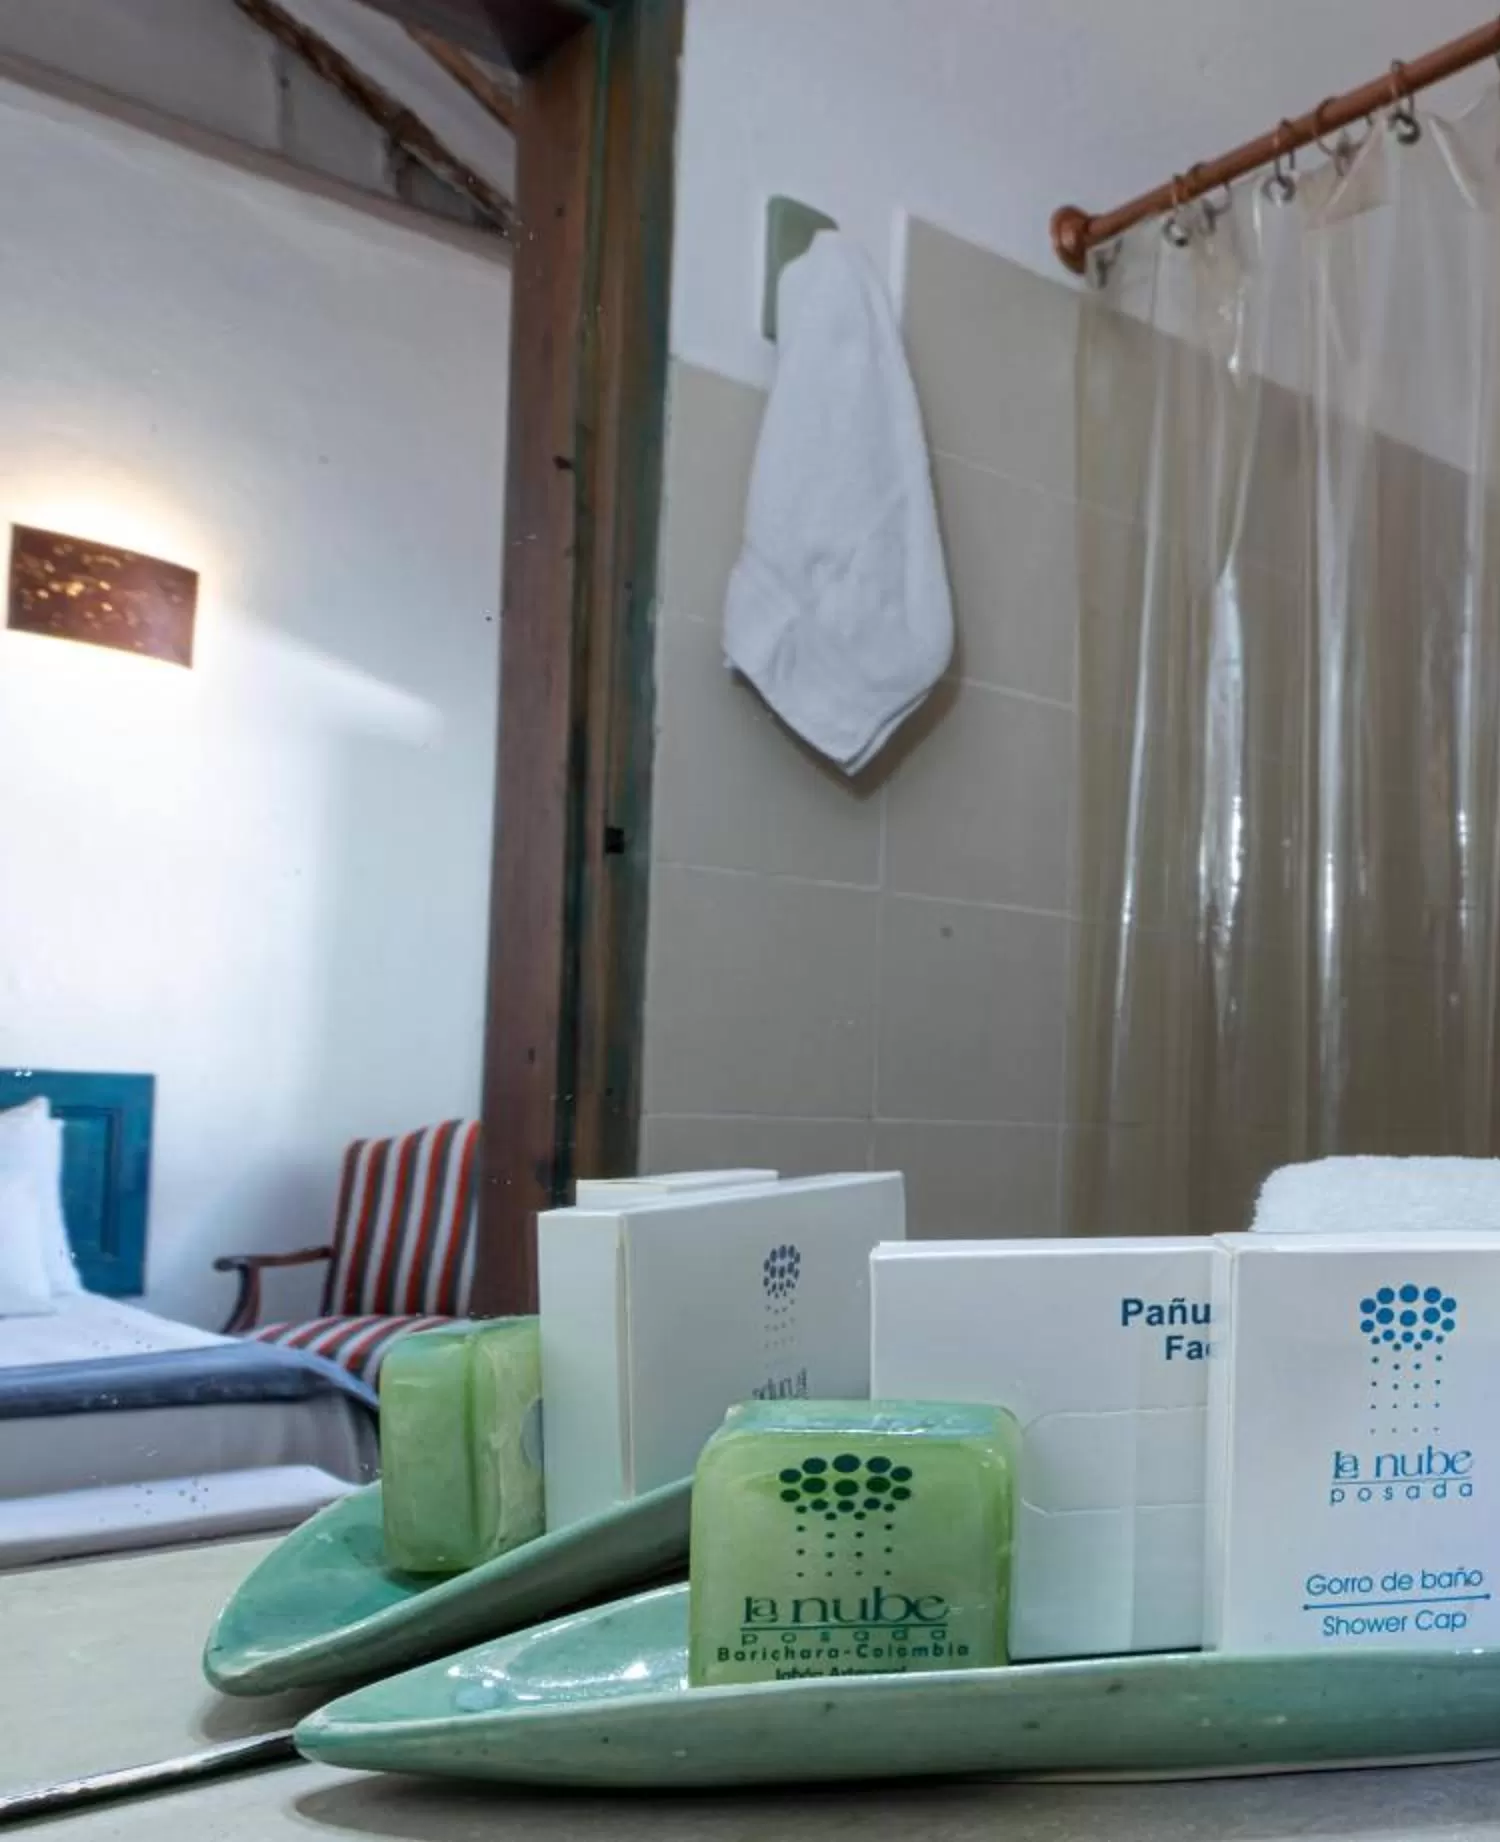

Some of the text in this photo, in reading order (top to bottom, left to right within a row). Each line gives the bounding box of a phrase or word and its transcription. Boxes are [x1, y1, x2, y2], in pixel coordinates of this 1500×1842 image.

[1121, 1297, 1211, 1327] Pañu
[1332, 1445, 1474, 1479] la nube
[1331, 1481, 1474, 1506] posada
[1305, 1565, 1483, 1598] Gorro de baño
[744, 1586, 949, 1624] la nube
[741, 1628, 947, 1646] posada
[1322, 1609, 1467, 1636] Shower Cap
